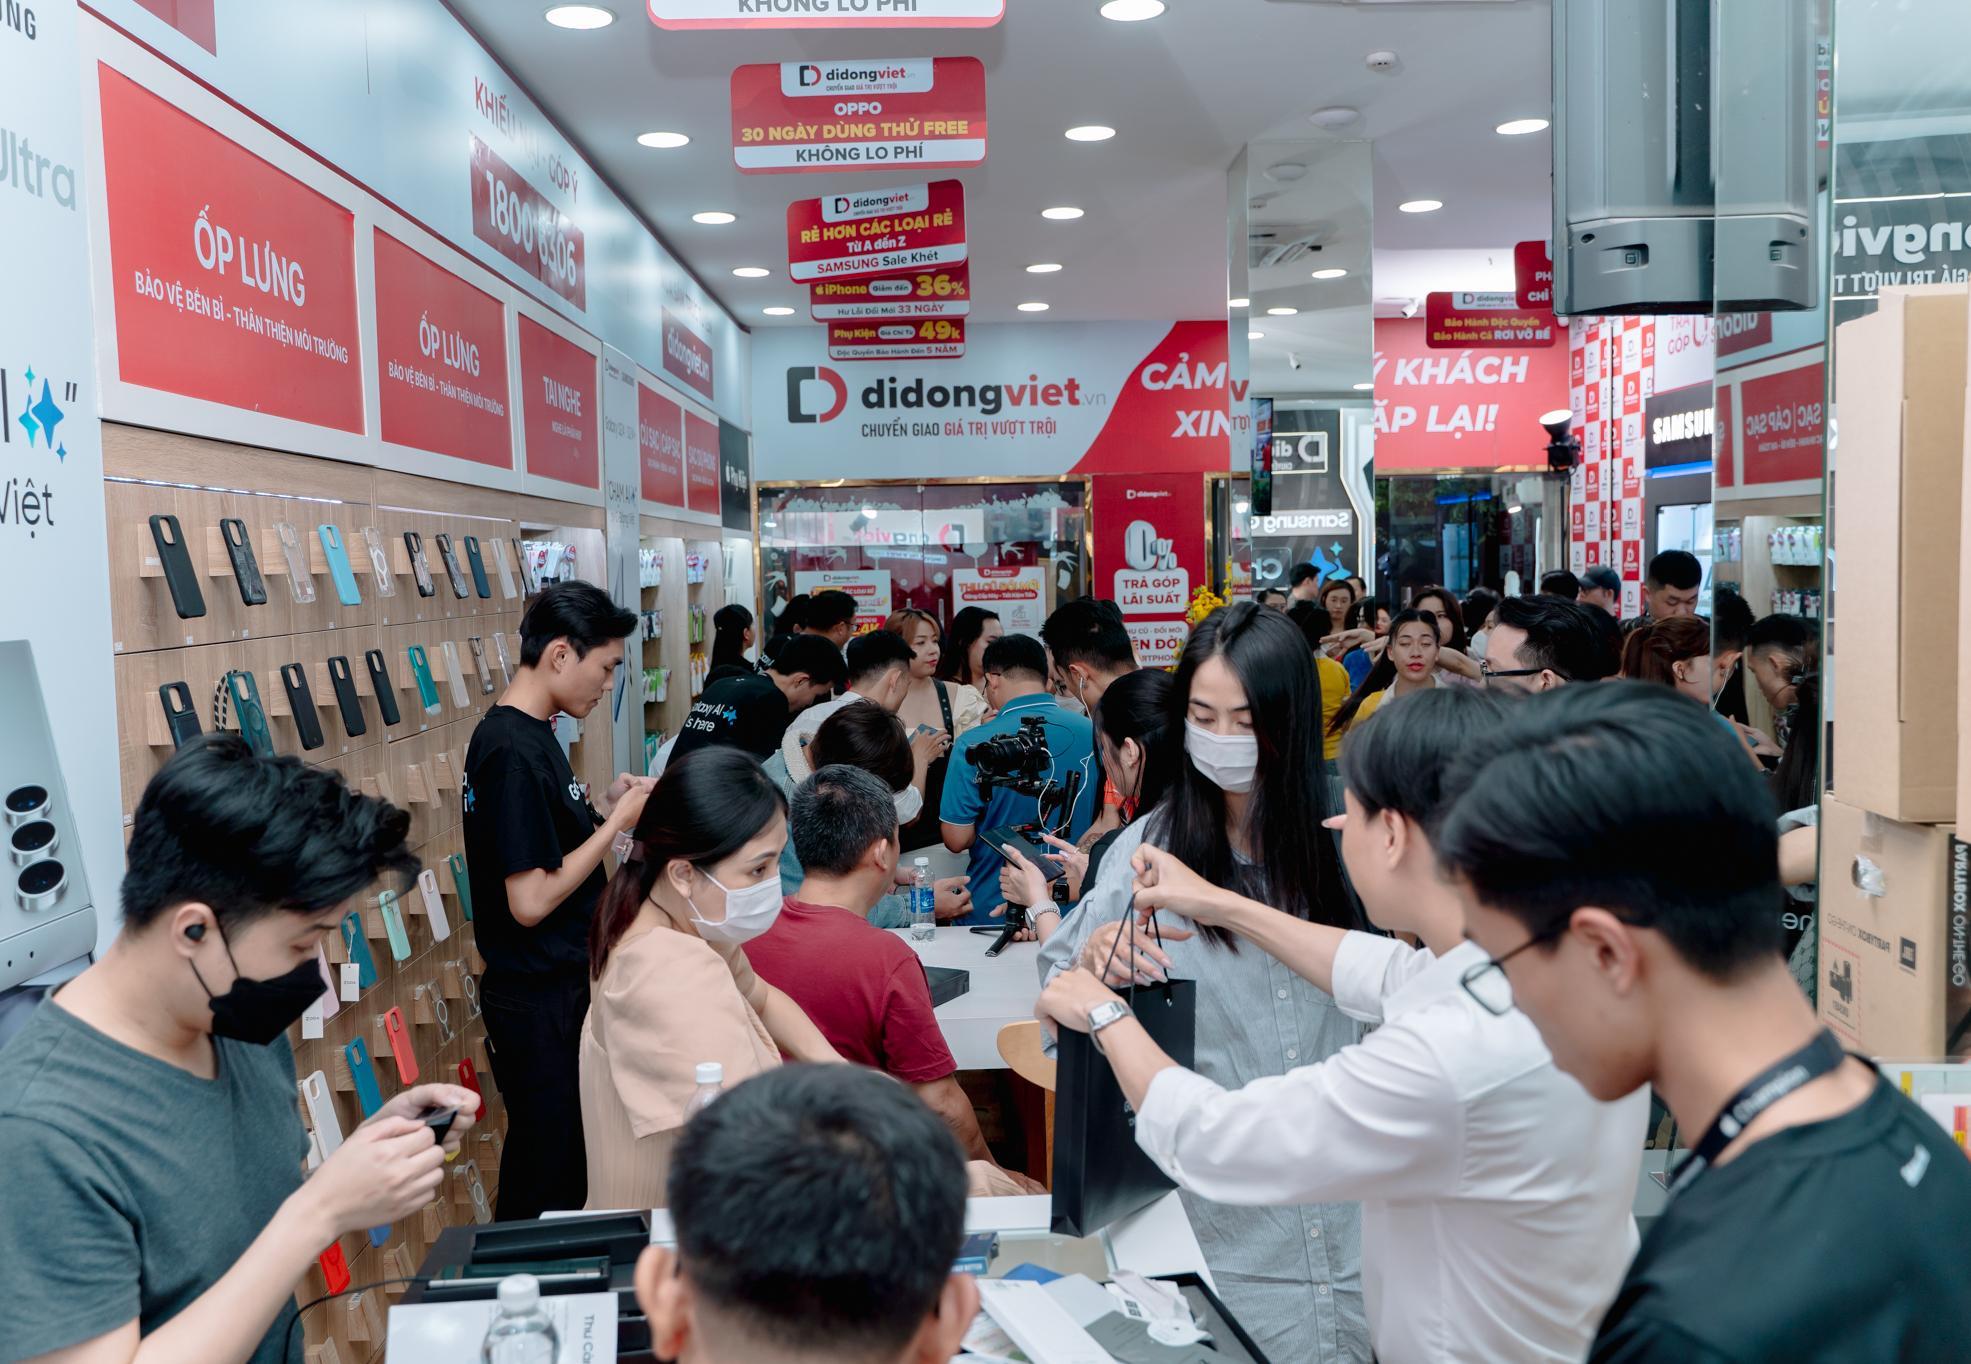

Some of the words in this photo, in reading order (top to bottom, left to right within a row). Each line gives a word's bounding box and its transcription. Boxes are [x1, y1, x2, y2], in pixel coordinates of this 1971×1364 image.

[834, 101, 882, 116] OPPO
[741, 127, 764, 142] 30
[768, 122, 818, 141] NGÀY
[822, 120, 877, 140] DÙNG
[881, 117, 920, 137] THỬ
[924, 120, 969, 136] FREE
[796, 144, 861, 162] KHÔNG
[865, 146, 888, 161] LO
[893, 142, 924, 160] PHÍ
[485, 169, 534, 254] 1800
[801, 224, 820, 243] RẺ
[823, 225, 857, 241] HƠN
[860, 219, 891, 237] CÁC
[894, 215, 929, 233] LOẠI
[933, 208, 953, 227] RẺ
[194, 204, 234, 276] ỐP
[846, 240, 862, 254] Từ
[863, 240, 872, 252] A
[874, 235, 896, 250] đến
[898, 235, 906, 247] Z
[817, 257, 879, 274] SAMSUNG
[882, 254, 907, 267] Sale
[825, 283, 867, 295] iPhone
[916, 274, 965, 297] 36%
[134, 267, 164, 300] BẢO
[166, 280, 184, 312] VỆ
[233, 306, 263, 334] THÂN
[264, 319, 293, 347] THIỆN
[897, 305, 911, 314] 33
[419, 310, 440, 359] ỐP
[1141, 353, 1228, 392] CẢM
[1393, 350, 1529, 385] KHÁCH
[542, 376, 558, 407] TAI
[559, 385, 582, 416] NGHE
[861, 416, 907, 438] CHUYỂN
[912, 422, 939, 438] GIAO
[944, 418, 964, 437] GIÁ
[969, 422, 988, 440] TRỊ
[991, 419, 1025, 441] VƯỢT
[1029, 416, 1057, 440] TRỘI
[1426, 404, 1499, 440] LẠI!
[1125, 519, 1177, 571] 0%
[1123, 575, 1150, 589] TRẢ
[1152, 575, 1181, 588] GÓP
[1122, 592, 1143, 605] LÃI
[1147, 589, 1181, 605] SUẤT
[693, 717, 715, 732] here
